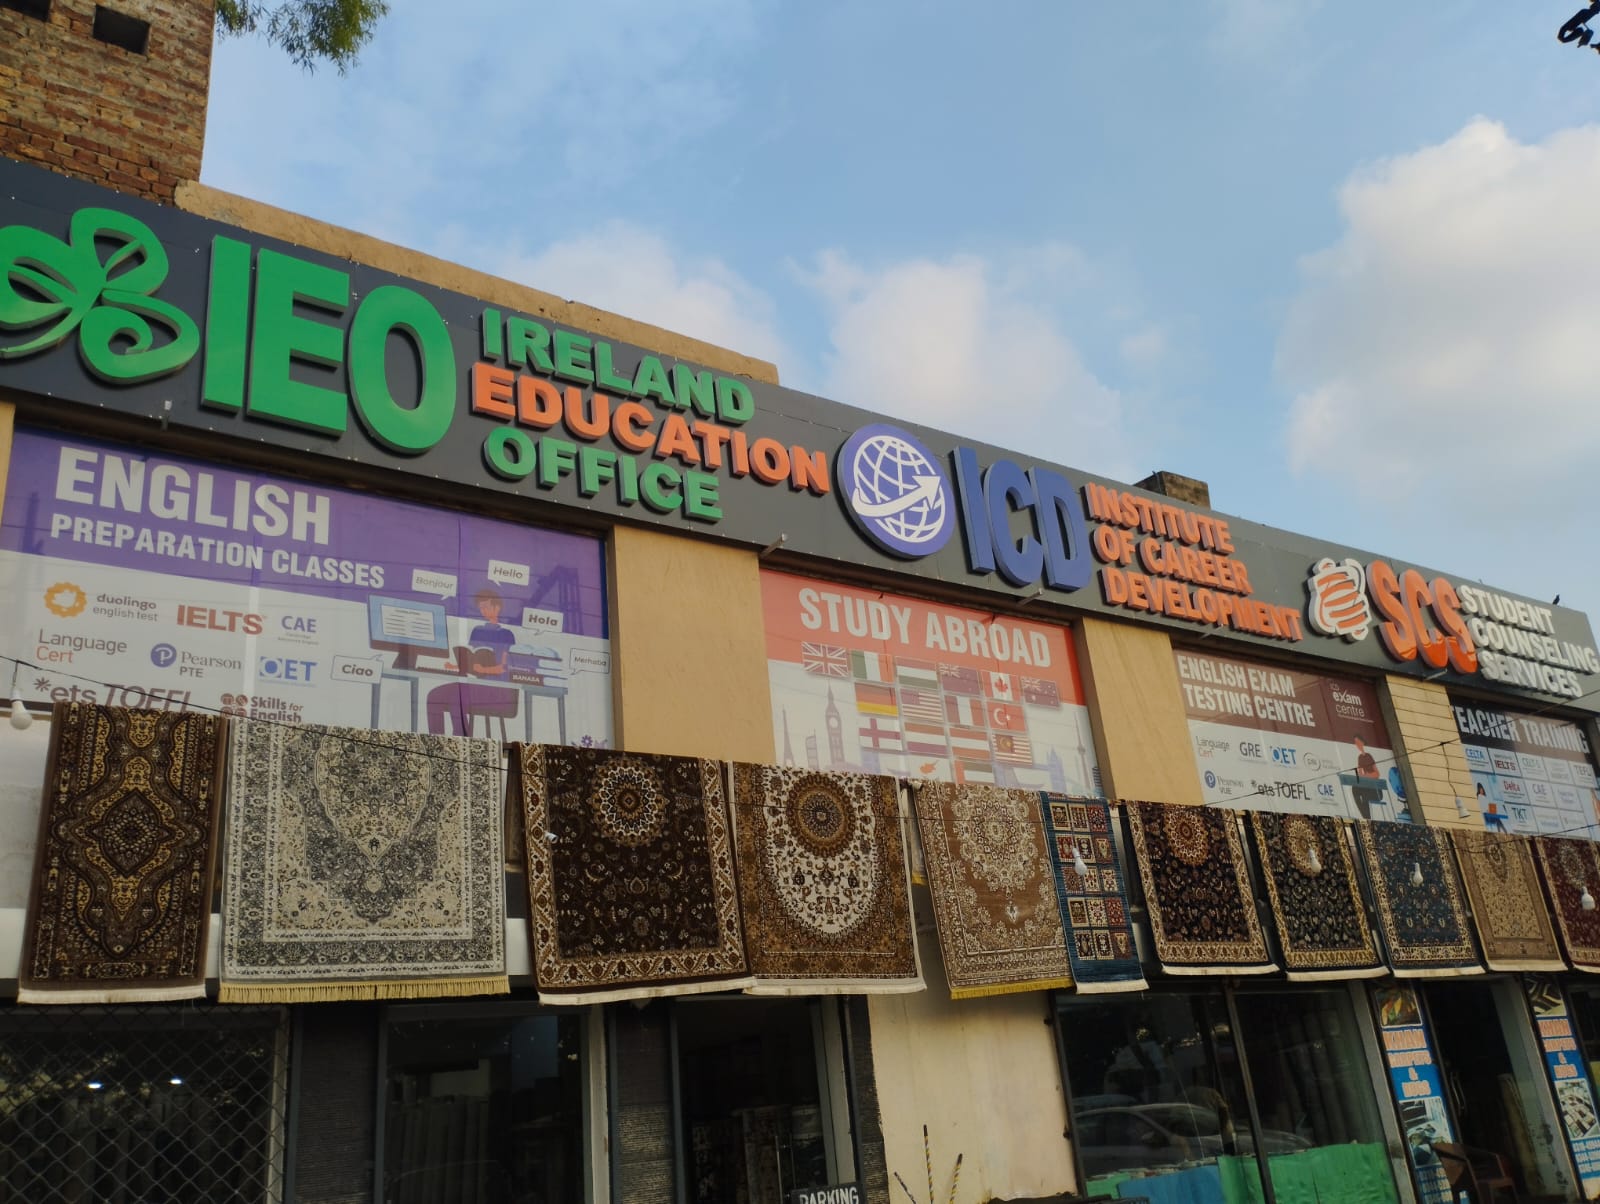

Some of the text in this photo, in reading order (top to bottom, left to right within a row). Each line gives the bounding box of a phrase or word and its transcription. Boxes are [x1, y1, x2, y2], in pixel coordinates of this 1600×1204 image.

[201, 234, 457, 454] IEO
[482, 307, 755, 425] IRELAND
[471, 361, 830, 494] EDUCATION
[483, 426, 723, 522] OFFICE
[55, 446, 331, 545] ENGLISH
[952, 445, 1092, 591] ICD
[1083, 481, 1235, 555] INSTITUTE
[50, 513, 385, 590] PREPARATION CLASSES
[1093, 525, 1254, 595] OF CAREER
[415, 575, 455, 591] Bonjour
[493, 566, 523, 580] Hello
[96, 592, 157, 611] duolingo
[1101, 567, 1303, 642] DEVELOPMENT
[1456, 584, 1556, 634] STUDENT
[92, 605, 158, 622] english test
[177, 604, 264, 635] IELTS
[281, 615, 317, 634] CAE
[528, 613, 558, 626] Hola
[1366, 560, 1478, 674] SCS
[799, 587, 1051, 668] STUDY ABROAD
[38, 629, 128, 655] Language
[1467, 616, 1600, 674] COUNSELING
[36, 646, 74, 664] Cert
[181, 650, 242, 671] Pearson
[179, 666, 204, 679] PTE
[341, 663, 375, 678] Ciao
[1177, 655, 1296, 698] ENGLISH EXAM
[1477, 650, 1583, 698] SERVICES
[250, 695, 304, 713] Skills for
[1182, 683, 1316, 728] TESTING CENTRE
[1332, 690, 1362, 706] exam
[250, 708, 302, 724] English
[1335, 704, 1365, 718] centre
[1451, 706, 1591, 754] EACHER TRAINING
[1195, 735, 1230, 752] Language
[1239, 741, 1262, 758] GRE
[1274, 781, 1311, 801] TOEFL
[1317, 783, 1335, 797] CAE
[1511, 807, 1527, 821] TKT
[799, 1186, 860, 1204] PARKING
